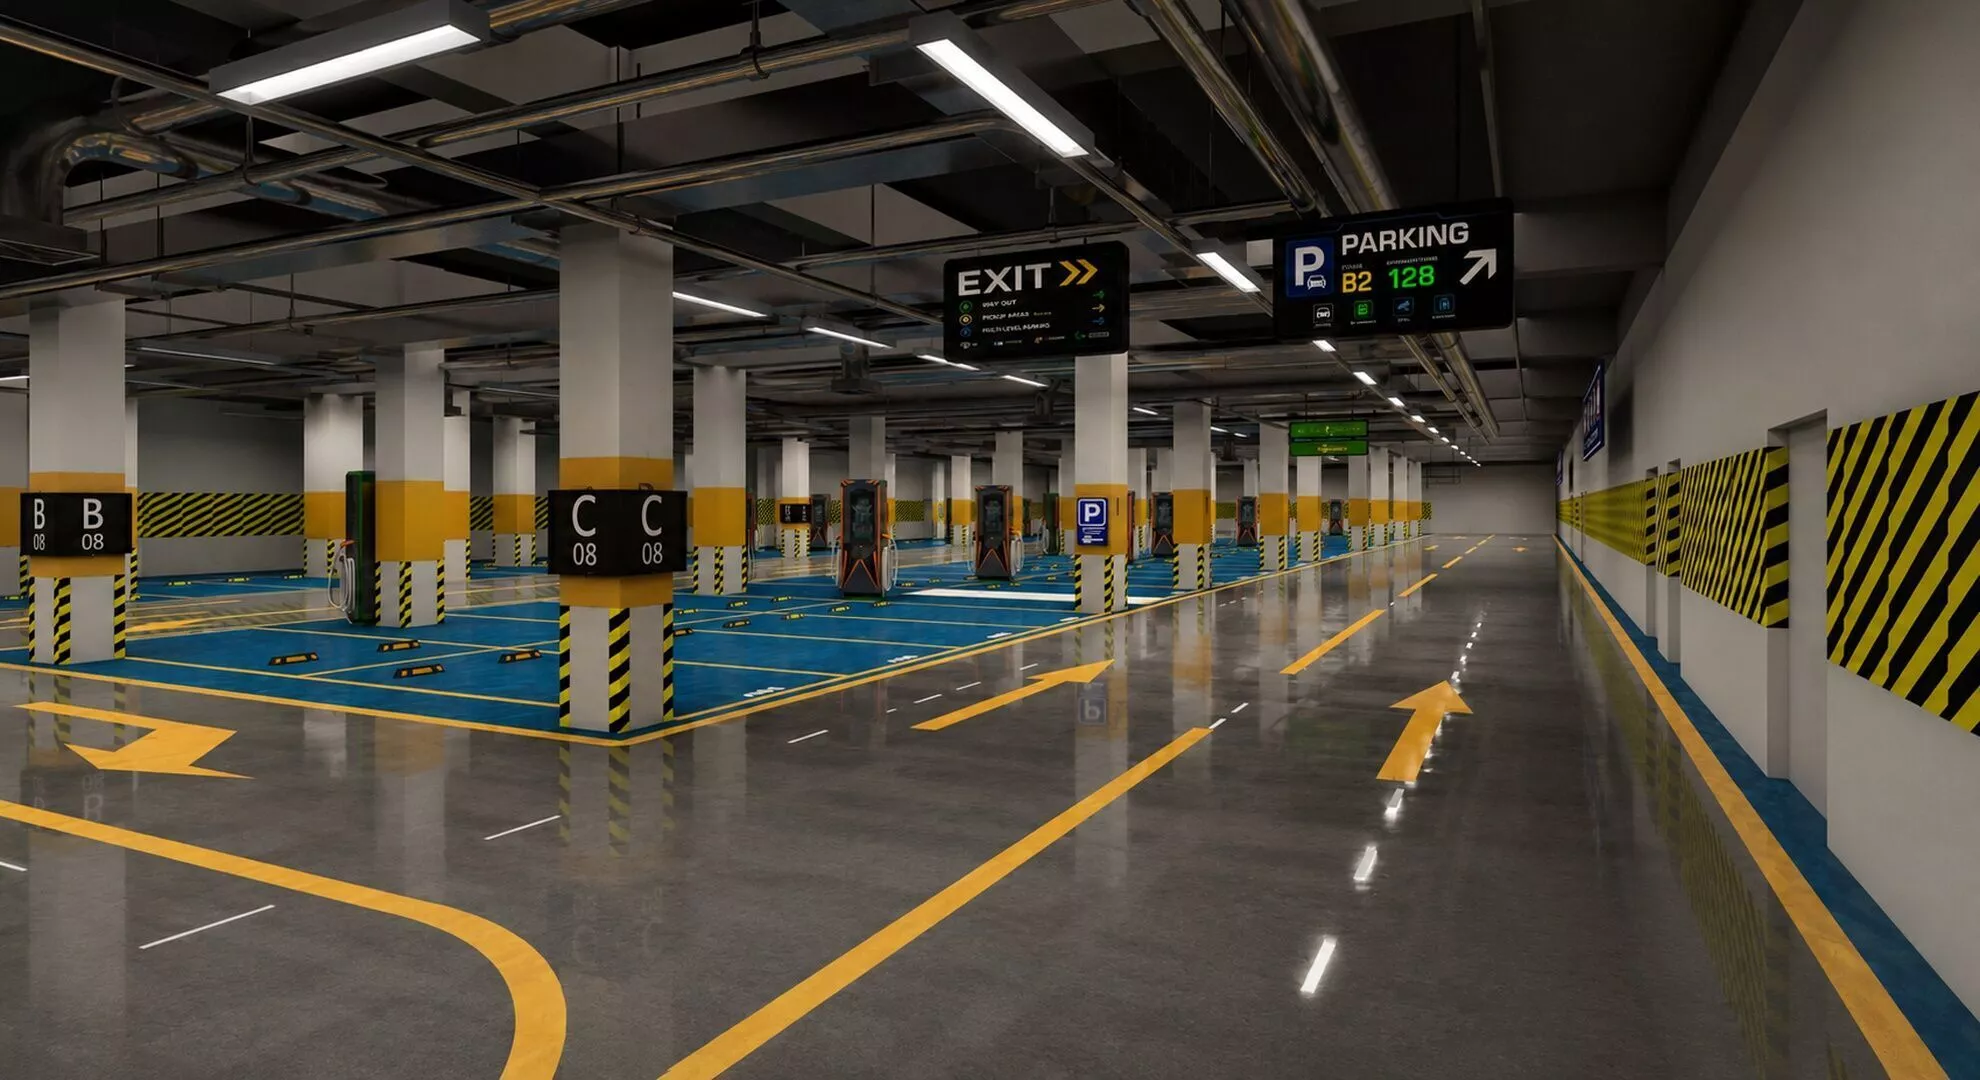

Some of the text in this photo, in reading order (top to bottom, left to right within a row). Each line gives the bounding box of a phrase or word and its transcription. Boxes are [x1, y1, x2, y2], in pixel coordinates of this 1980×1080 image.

[1342, 222, 1469, 256] PARKING
[1294, 245, 1325, 287] P
[1387, 264, 1435, 289] 128
[958, 263, 1052, 296] EXIT
[1342, 271, 1372, 294] B2
[1001, 299, 1017, 307] OUT
[34, 498, 46, 530] B
[83, 498, 104, 530] B
[572, 494, 597, 538] C
[641, 494, 662, 537] C
[1084, 503, 1101, 522] P
[33, 533, 46, 551] 08
[81, 533, 105, 551] 08
[573, 542, 598, 566] 08
[642, 542, 663, 565] 08
